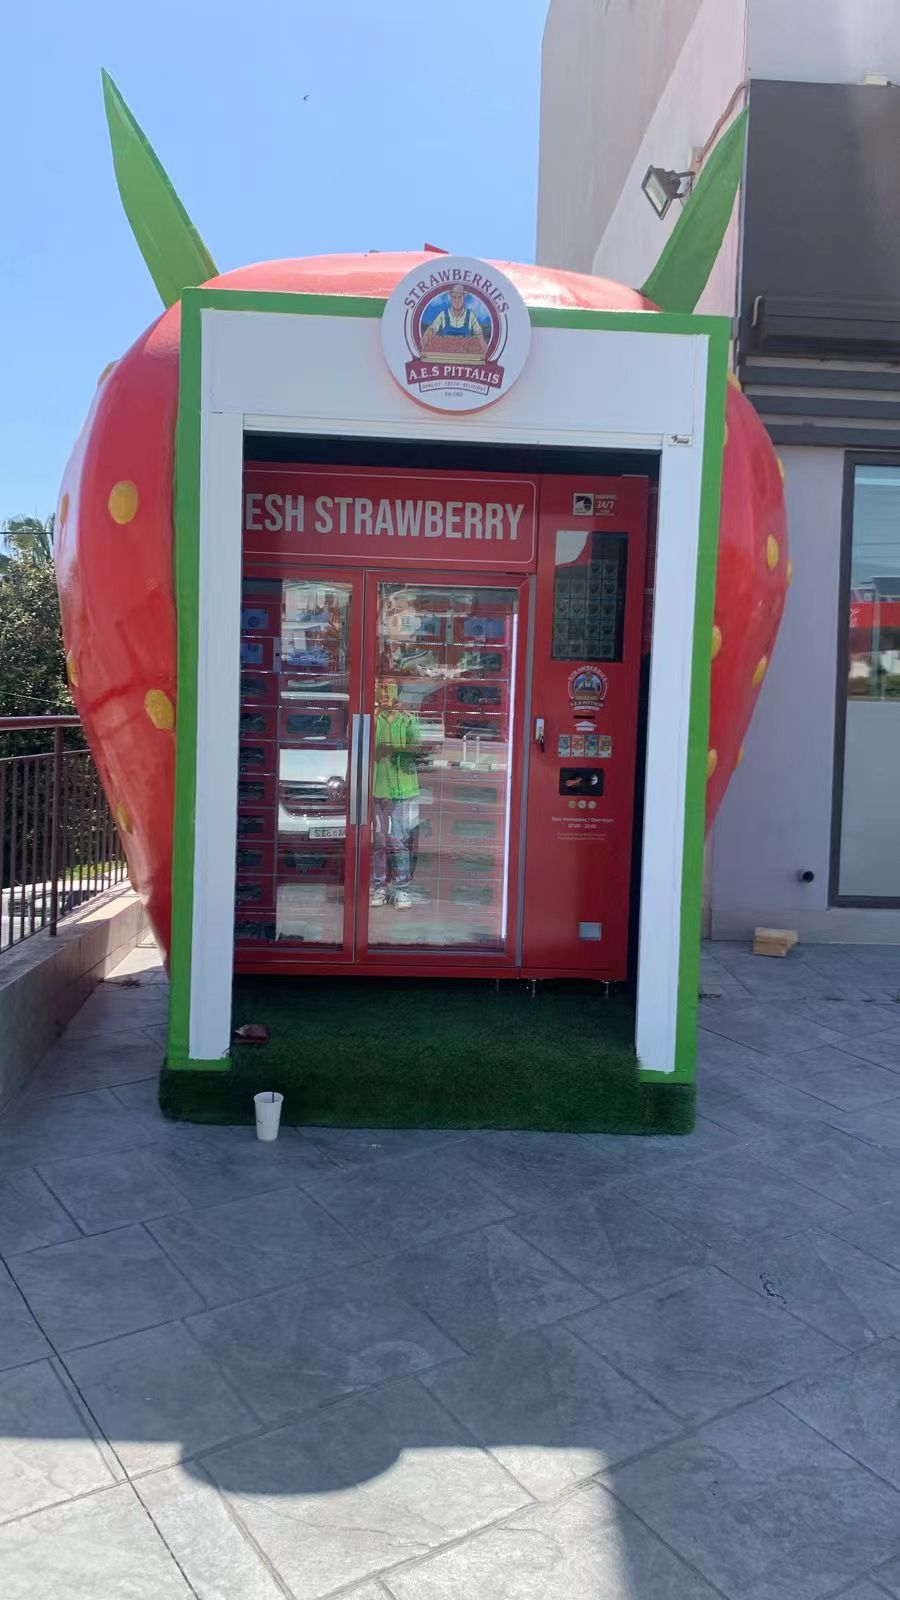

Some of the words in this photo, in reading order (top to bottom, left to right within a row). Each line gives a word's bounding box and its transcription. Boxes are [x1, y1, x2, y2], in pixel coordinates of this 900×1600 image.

[404, 268, 510, 313] STRAWBERRIES
[409, 367, 440, 381] A.E.S
[443, 366, 501, 385] PITTALIS
[245, 493, 305, 532] ESH
[315, 495, 525, 541] STRAWBERRY
